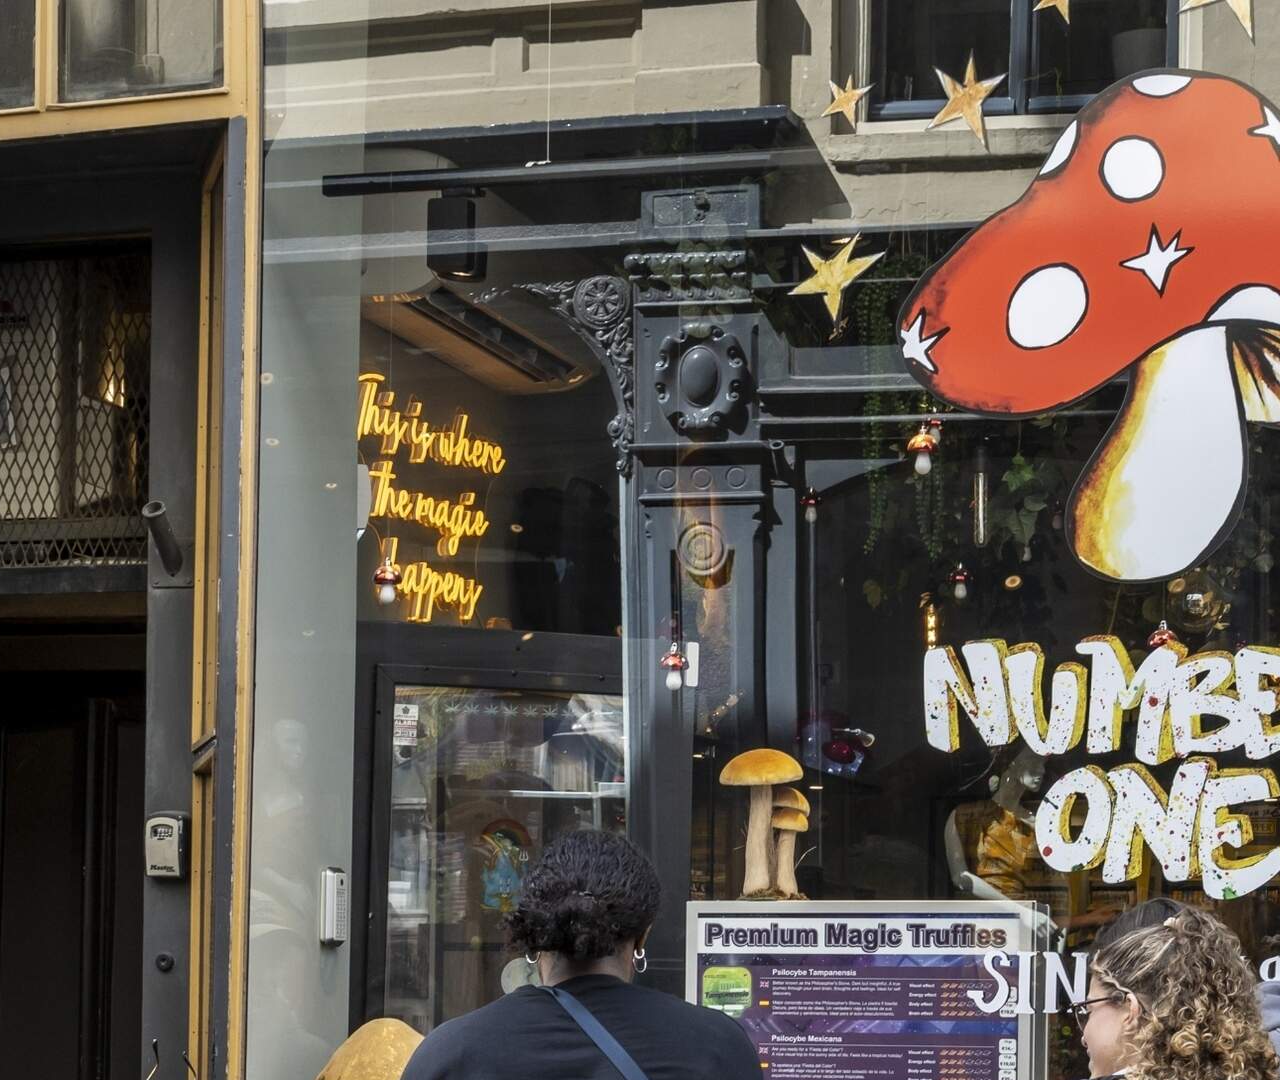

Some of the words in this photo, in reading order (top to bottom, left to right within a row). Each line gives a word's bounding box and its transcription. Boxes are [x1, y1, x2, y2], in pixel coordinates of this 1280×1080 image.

[358, 371, 408, 455] This
[408, 401, 436, 464] is
[433, 413, 507, 475] where
[368, 459, 414, 518] the
[414, 491, 490, 557] magic
[704, 922, 819, 948] Premium
[824, 921, 904, 953] Magic
[906, 923, 1009, 949] Truffles
[772, 968, 808, 977] Psilocybe
[808, 968, 857, 977] Tampanensis
[967, 949, 1090, 1015] SIN
[771, 1034, 808, 1044] Psilocybe
[807, 1035, 843, 1043] Mexicana
